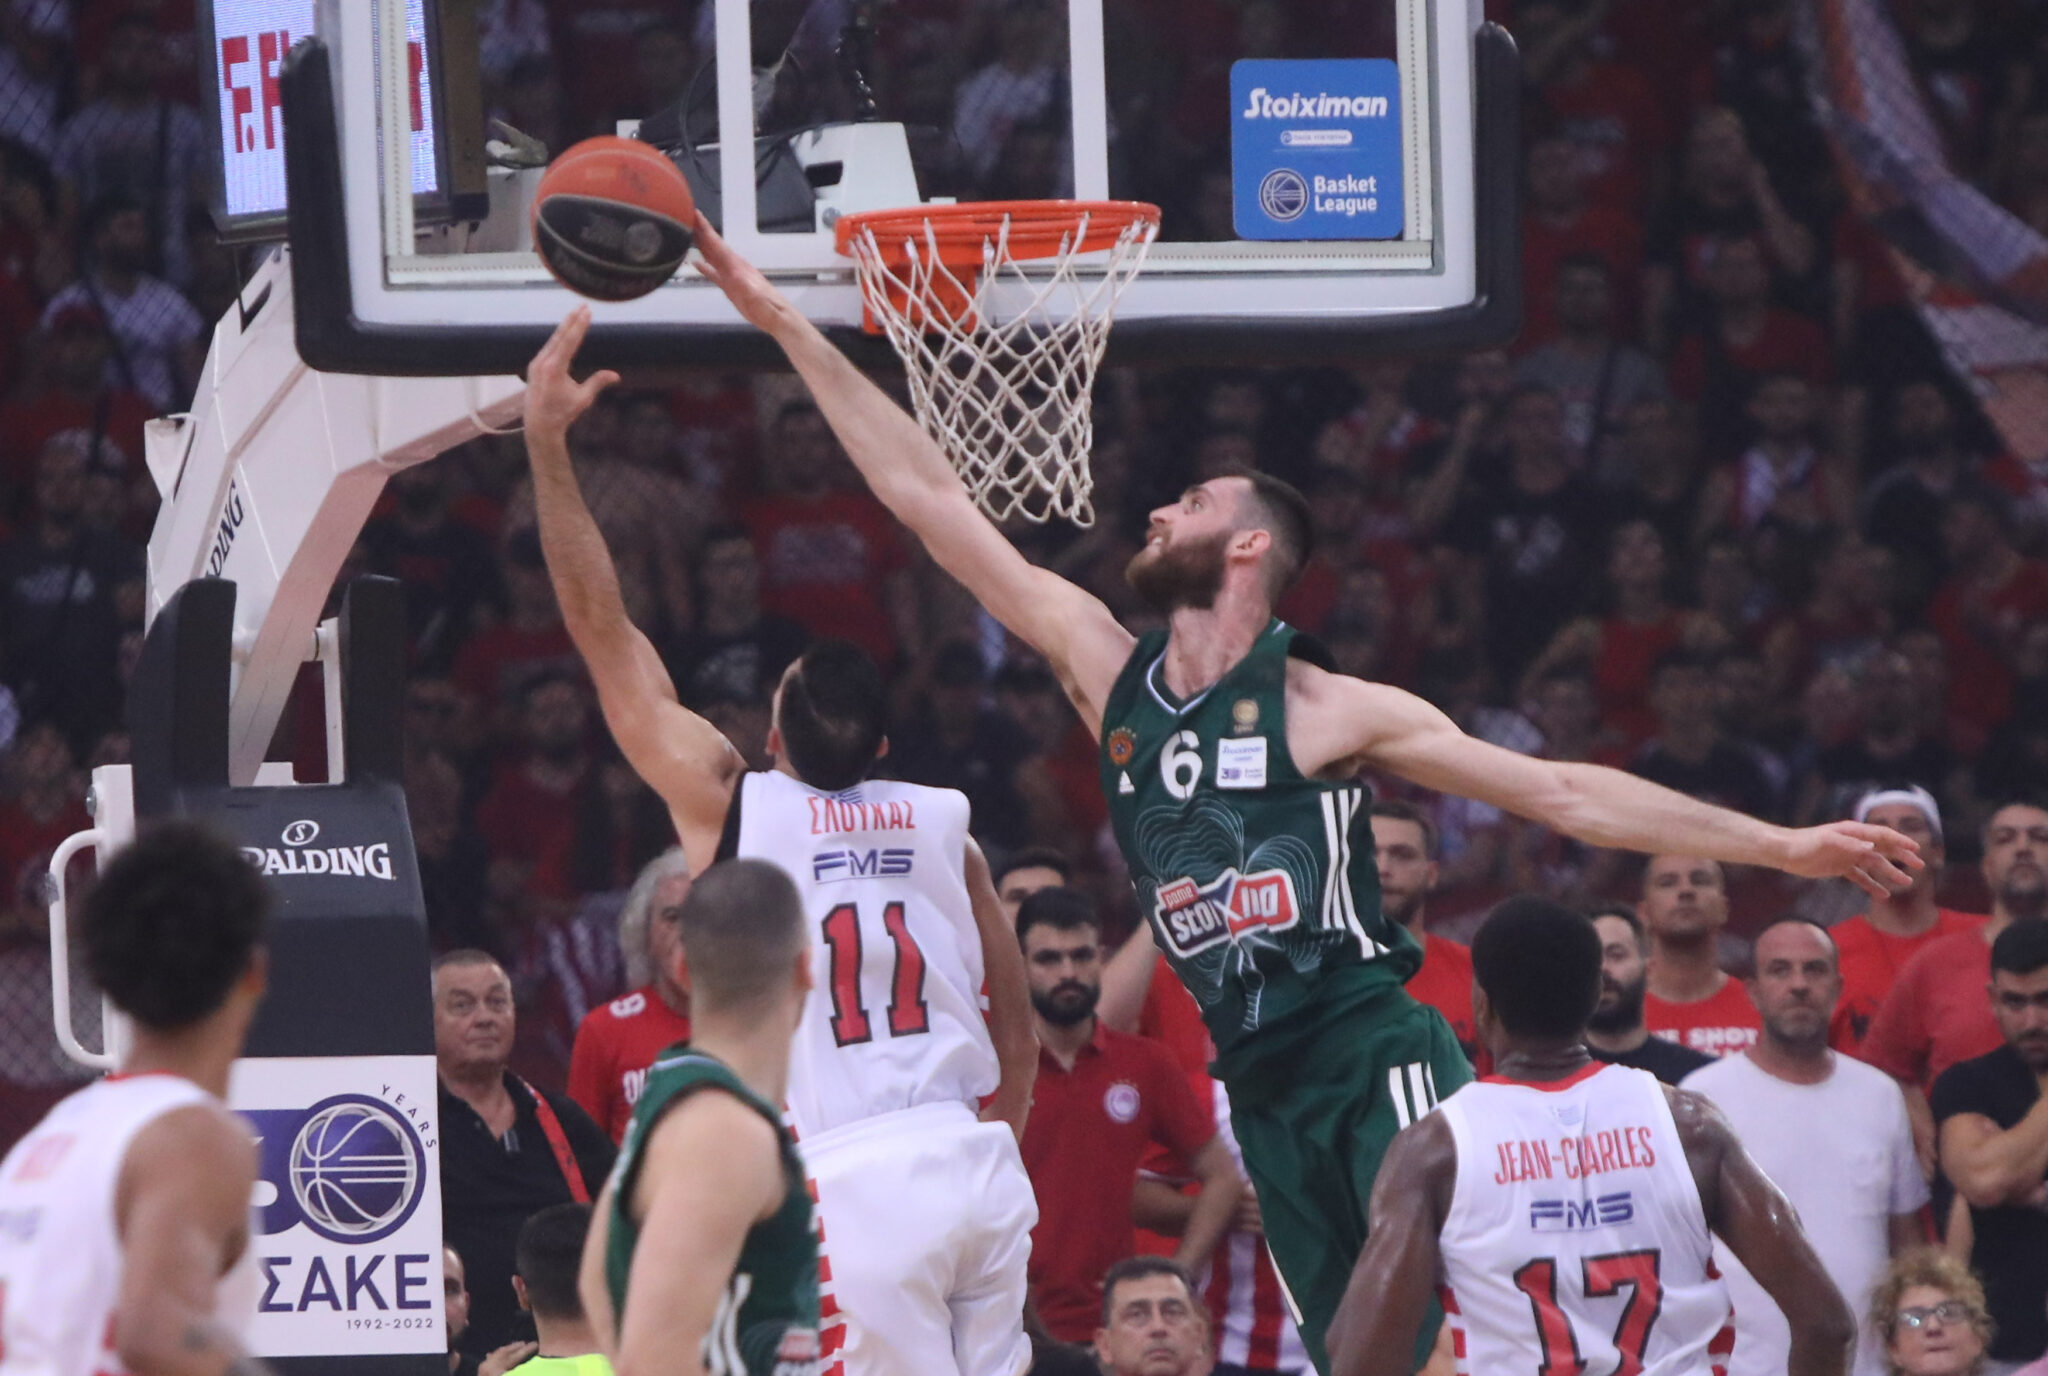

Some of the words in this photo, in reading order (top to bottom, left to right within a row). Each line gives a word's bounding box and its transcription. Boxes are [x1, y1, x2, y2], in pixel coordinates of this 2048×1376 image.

[1243, 87, 1388, 119] Stoiximan
[1313, 174, 1378, 193] Basket
[1314, 194, 1378, 216] League
[1160, 730, 1203, 800] 6
[240, 842, 393, 880] PALDING
[812, 848, 915, 881] FMS
[821, 901, 930, 1048] 11
[1688, 1026, 1758, 1048] SHOT
[380, 1084, 437, 1149] YEARS
[1530, 1190, 1634, 1229] FMS
[257, 1254, 432, 1313] ΣΑΚΕ
[346, 1318, 434, 1331] 1992-2022
[1513, 1248, 1664, 1376] 17
